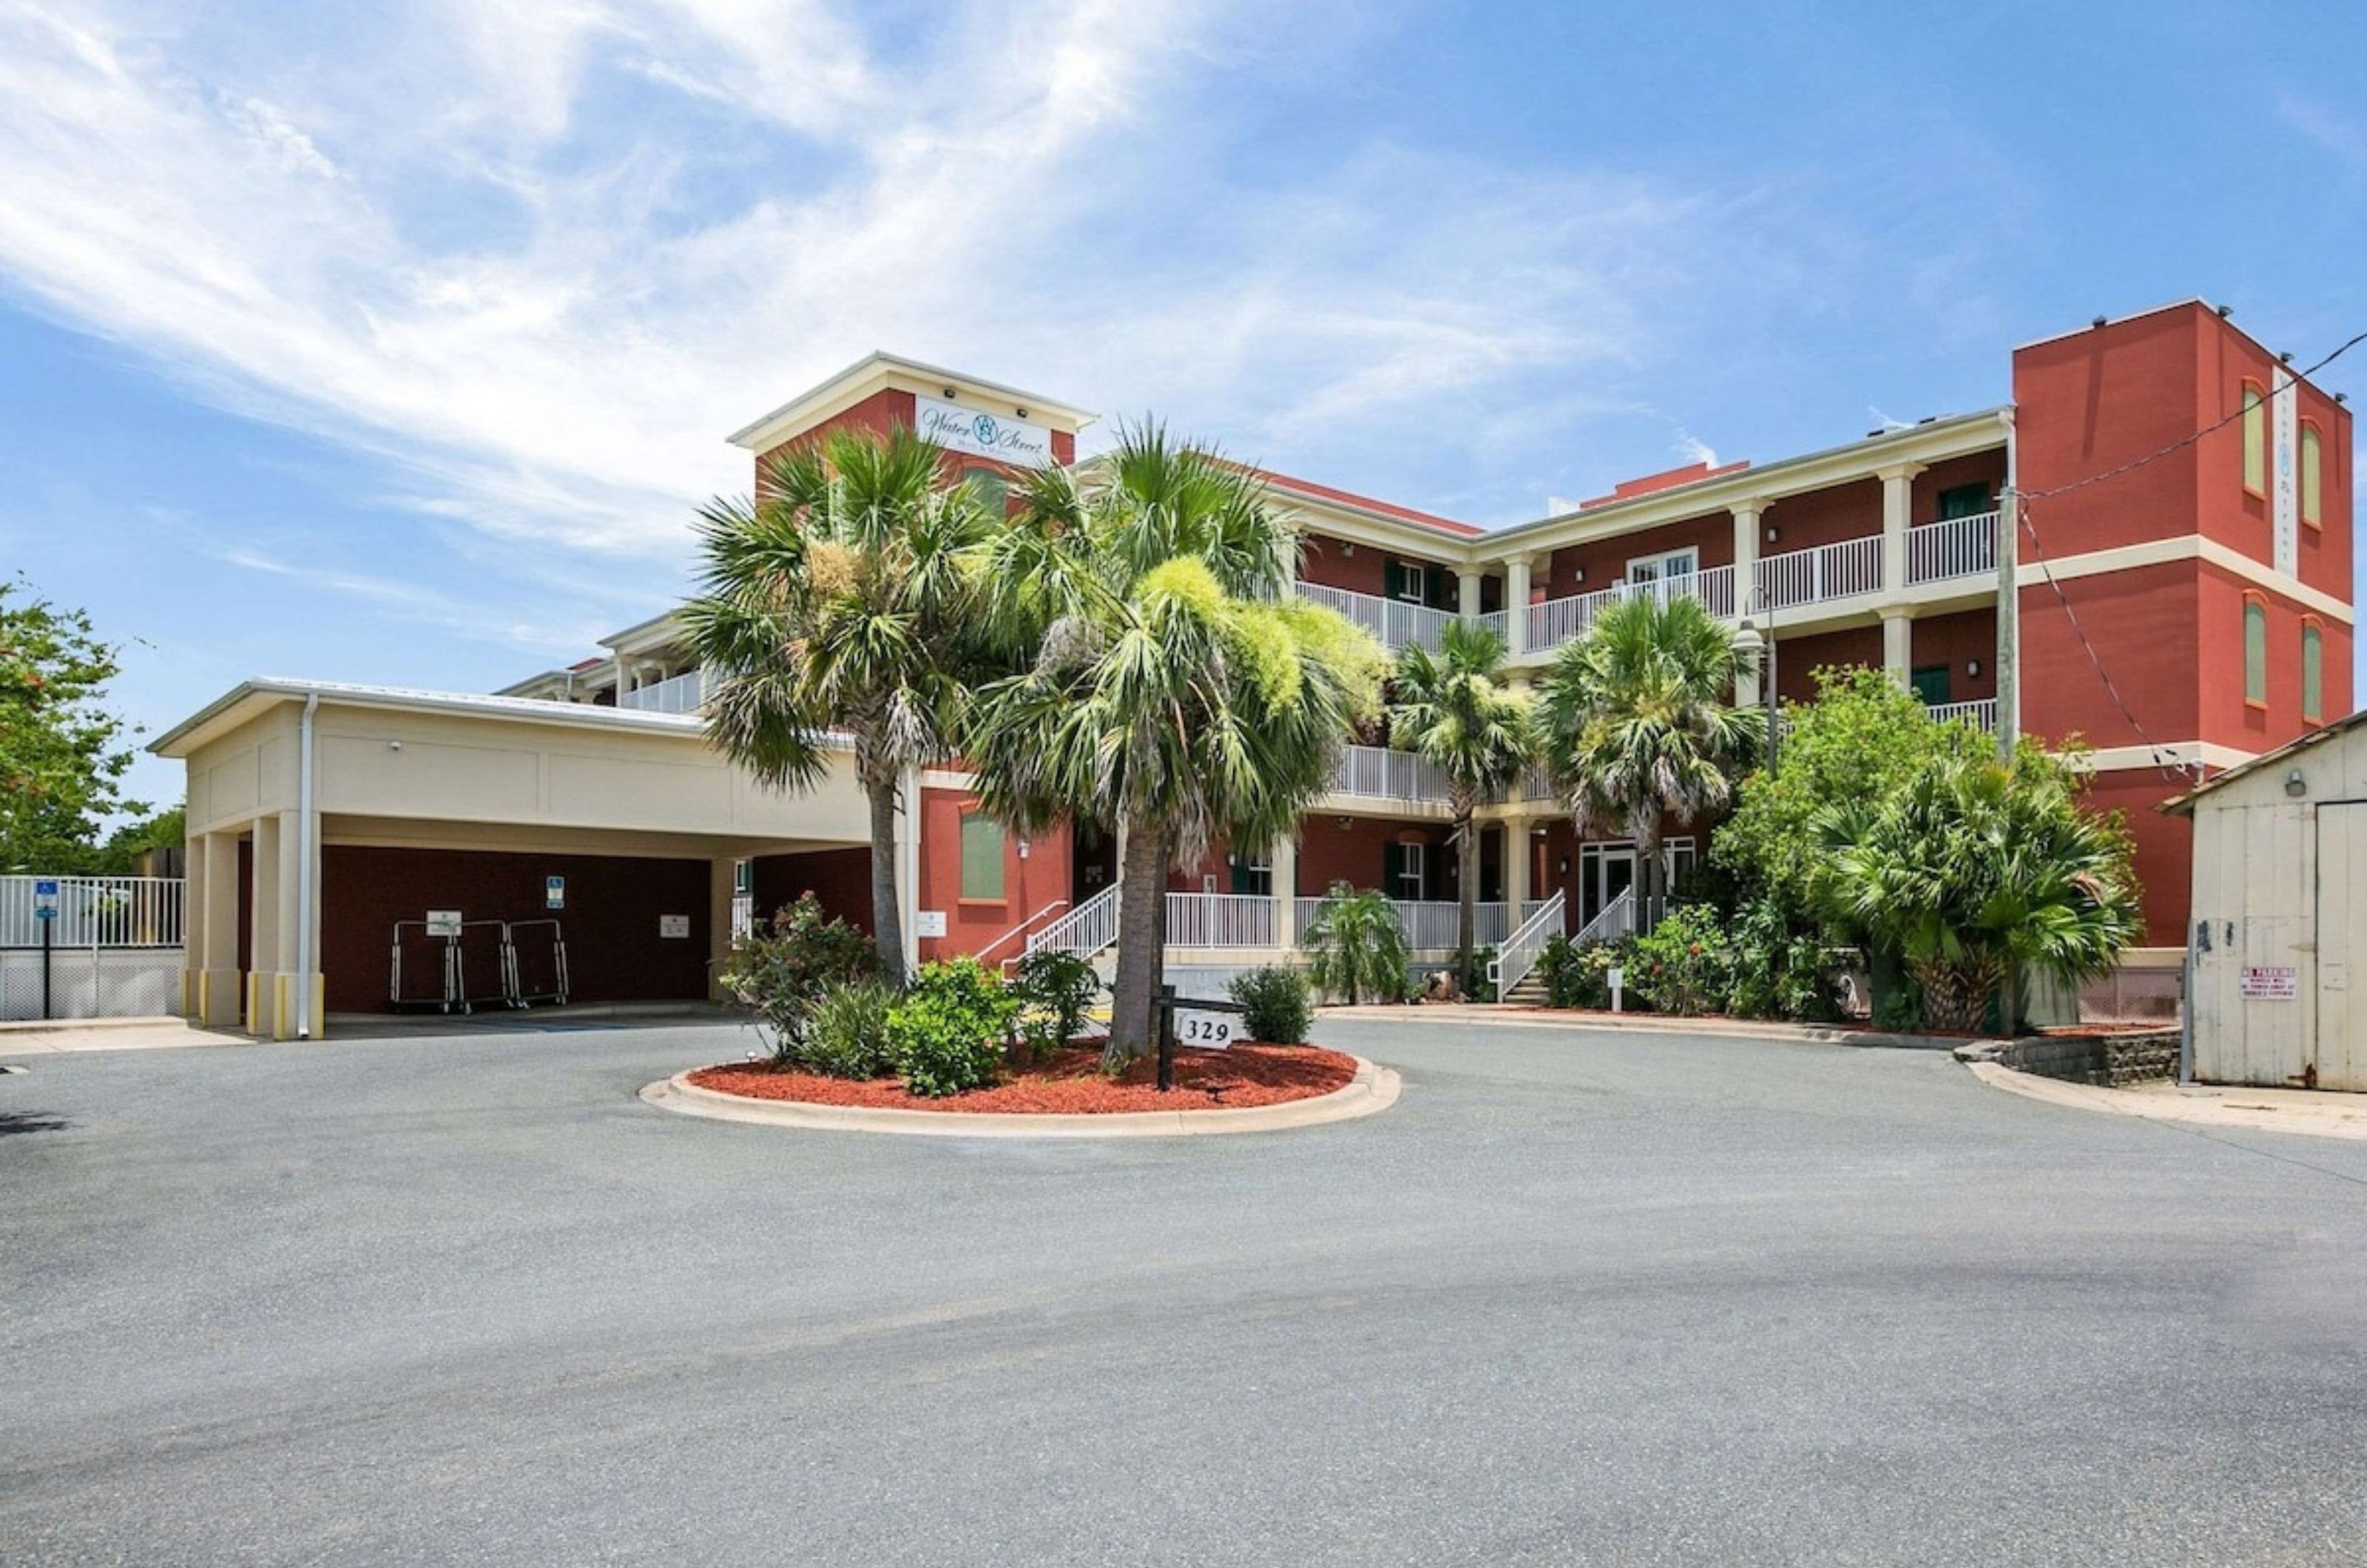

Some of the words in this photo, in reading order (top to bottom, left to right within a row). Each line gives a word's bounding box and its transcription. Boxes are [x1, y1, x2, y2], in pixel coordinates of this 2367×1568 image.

[922, 407, 971, 436] Water
[999, 429, 1043, 454] Street
[1185, 1020, 1229, 1041] 329
